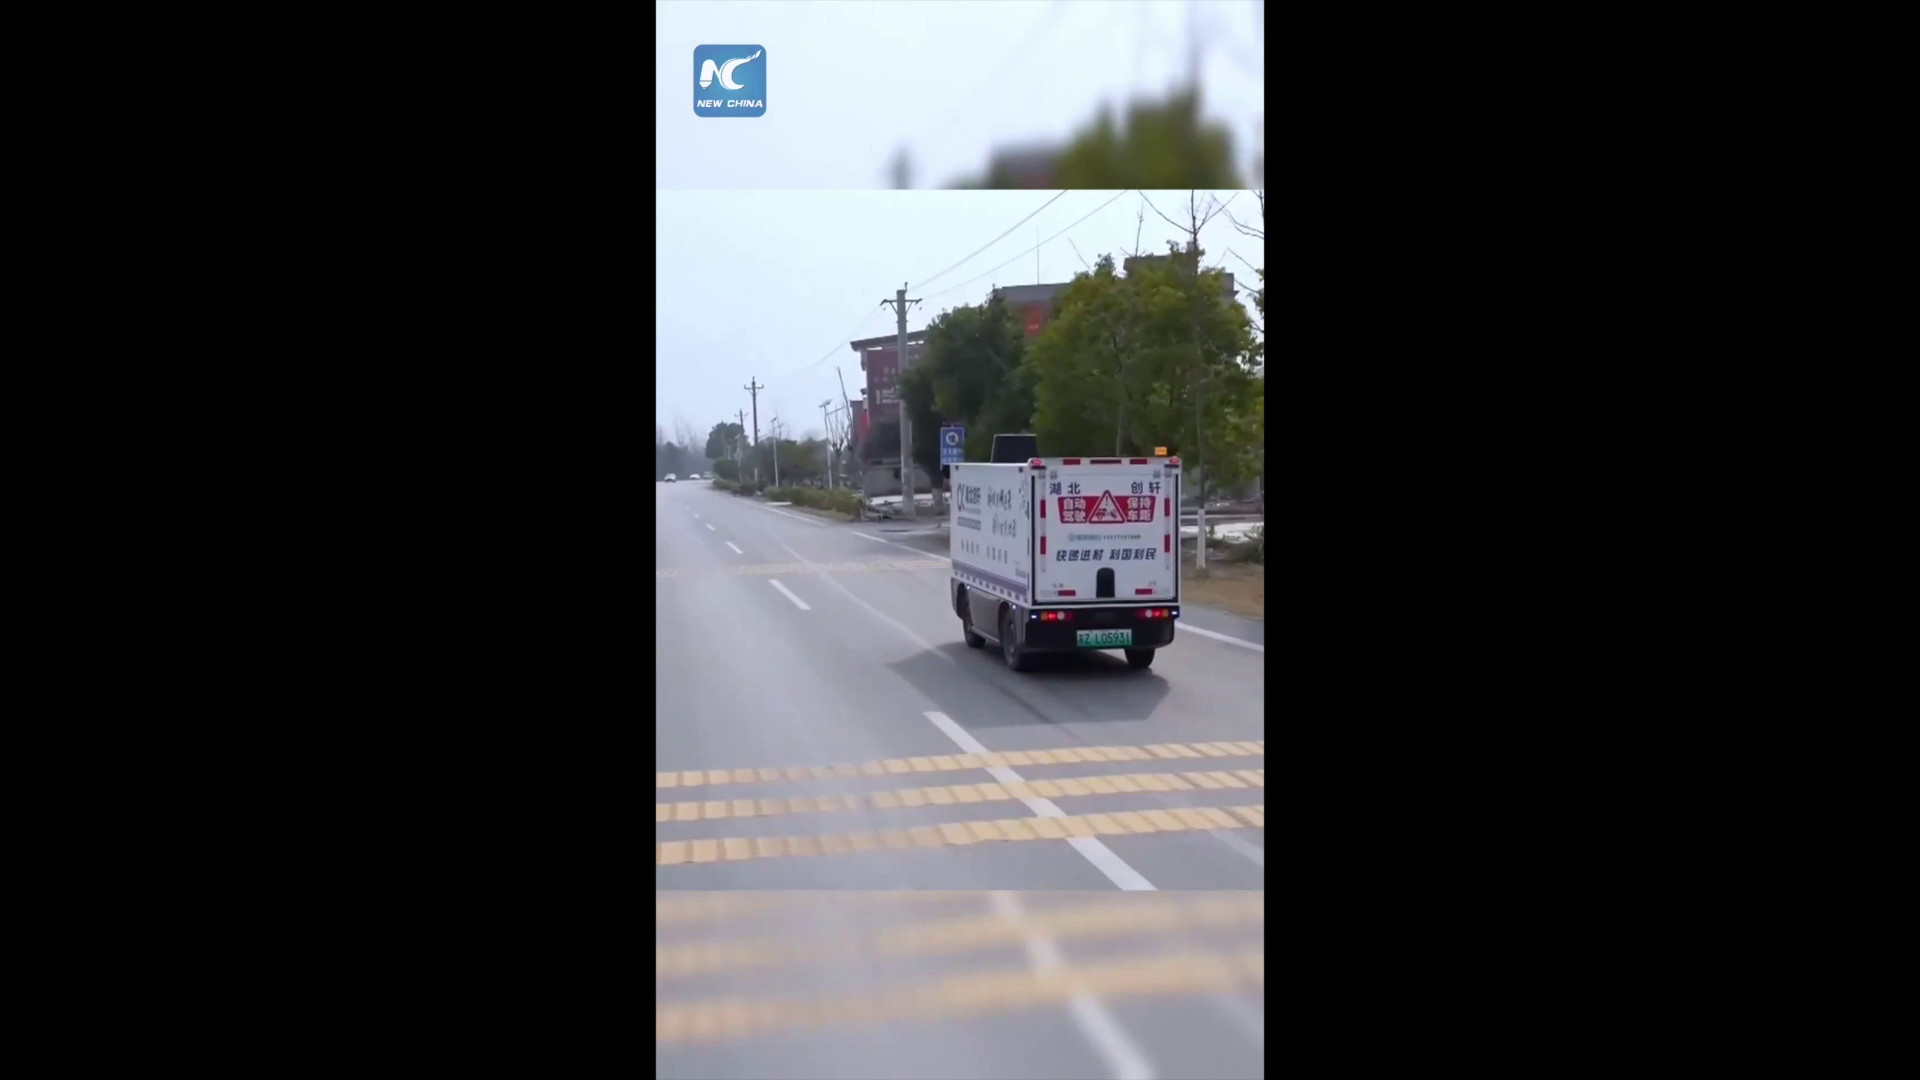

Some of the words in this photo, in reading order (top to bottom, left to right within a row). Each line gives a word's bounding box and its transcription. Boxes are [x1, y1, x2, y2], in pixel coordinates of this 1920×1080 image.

[1049, 482, 1081, 495] 湖北
[1131, 481, 1161, 495] 创轩
[1063, 497, 1086, 510] 自动
[1127, 496, 1151, 510] 保持
[1062, 510, 1086, 522] 驾驶
[1127, 510, 1151, 521] 车距
[1109, 548, 1157, 560] 利国利民
